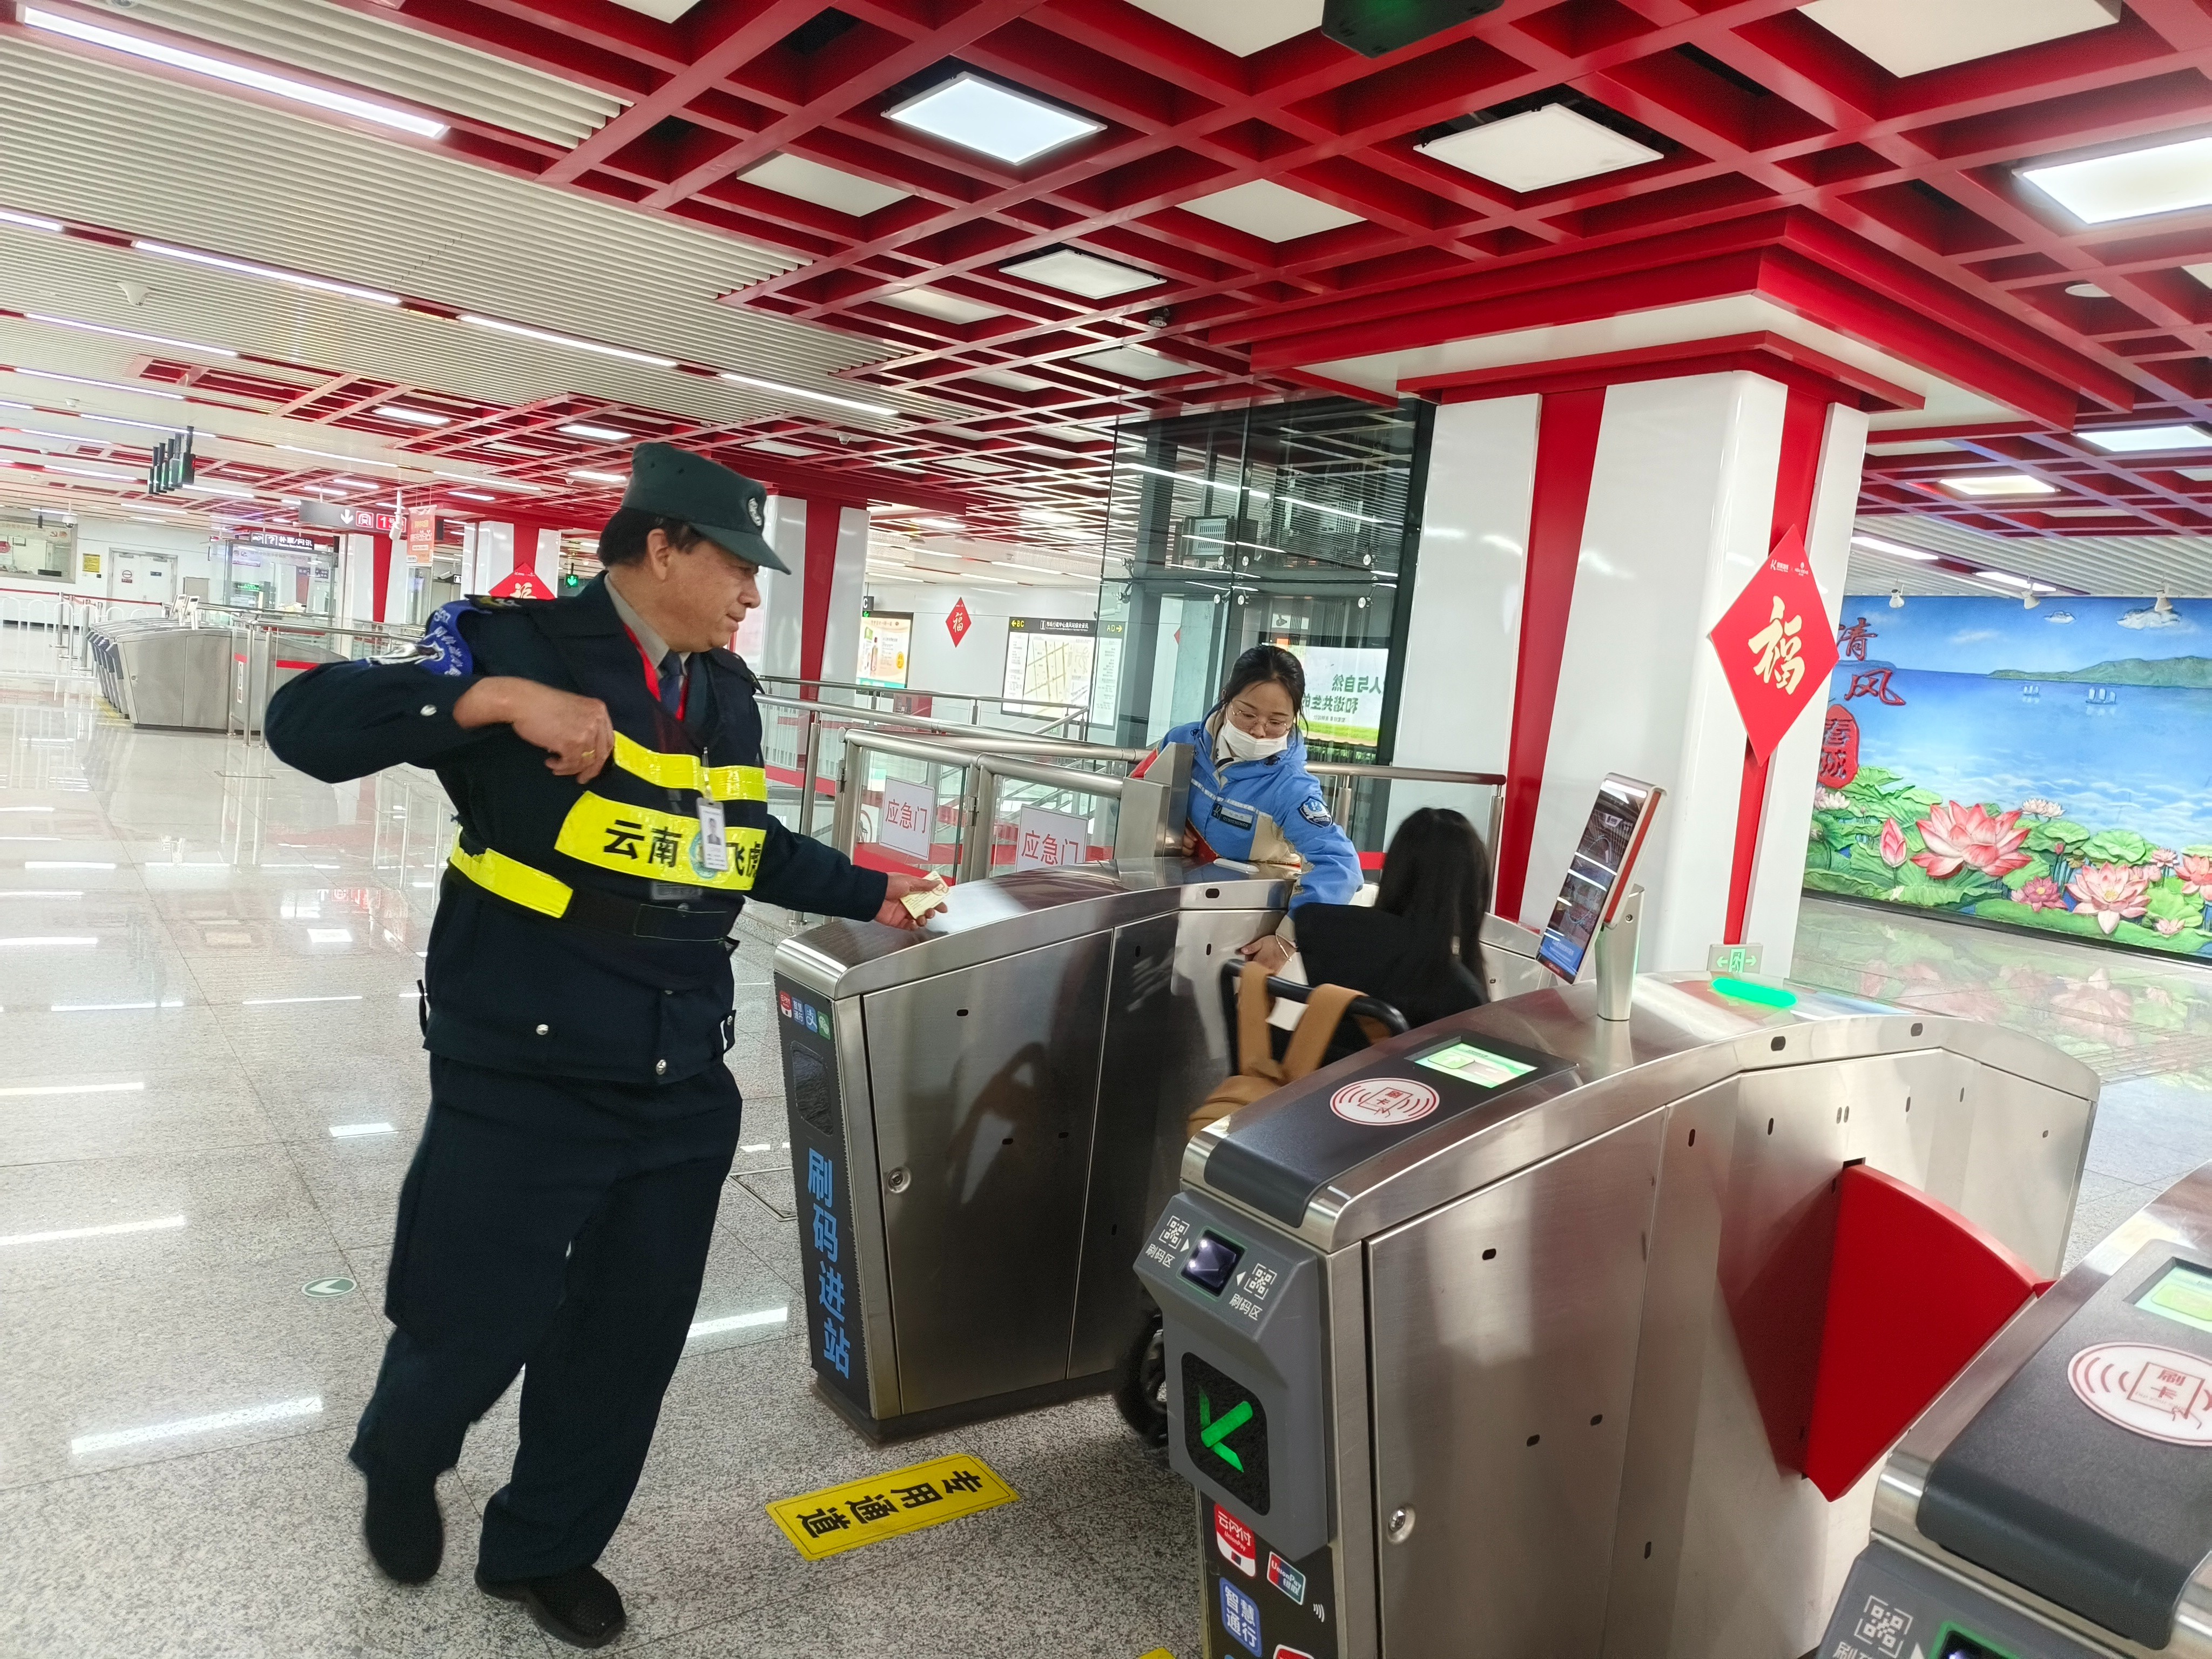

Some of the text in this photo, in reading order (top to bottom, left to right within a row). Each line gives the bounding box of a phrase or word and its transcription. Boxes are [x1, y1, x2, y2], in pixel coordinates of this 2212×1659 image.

[953, 612, 963, 633] 福
[1748, 596, 1805, 695] 福
[885, 799, 928, 834] 应急门
[604, 819, 683, 868] 云南
[1021, 830, 1079, 865] 应急门
[808, 1148, 850, 1379] 刷码进站
[1145, 1244, 1175, 1268] 刷码区
[1229, 1293, 1263, 1321] 刷码区
[2150, 1369, 2187, 1400] 刷卡
[796, 1470, 983, 1539] 专用通道
[1224, 1530, 1246, 1552] UnionPay
[1271, 1560, 1302, 1589] UnionPay
[1225, 1585, 1256, 1627] 智慧
[1226, 1608, 1257, 1648] 通行
